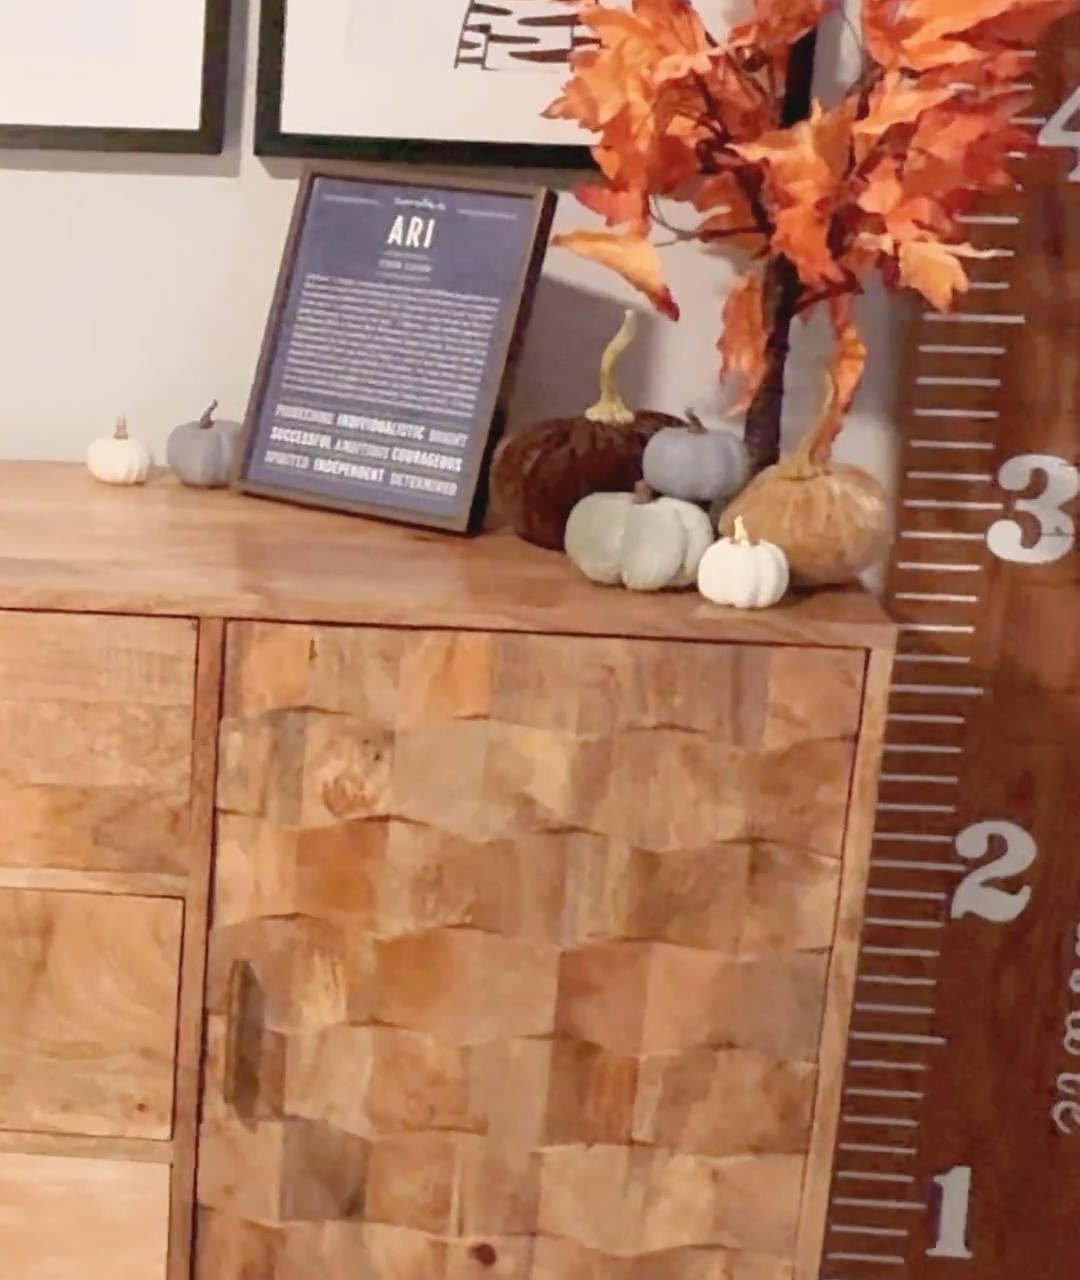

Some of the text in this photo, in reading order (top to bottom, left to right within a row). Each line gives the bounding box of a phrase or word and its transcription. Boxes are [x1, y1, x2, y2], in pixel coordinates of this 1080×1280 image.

[387, 214, 436, 248] ARI
[270, 426, 332, 450] SUCCESSFUL
[391, 446, 463, 472] COURAGEOUS
[312, 457, 386, 483] INDEPENDENT
[389, 471, 458, 497] DETERMINED
[985, 453, 1079, 563] 3
[950, 820, 1037, 922] 2
[925, 1166, 973, 1258] 1
